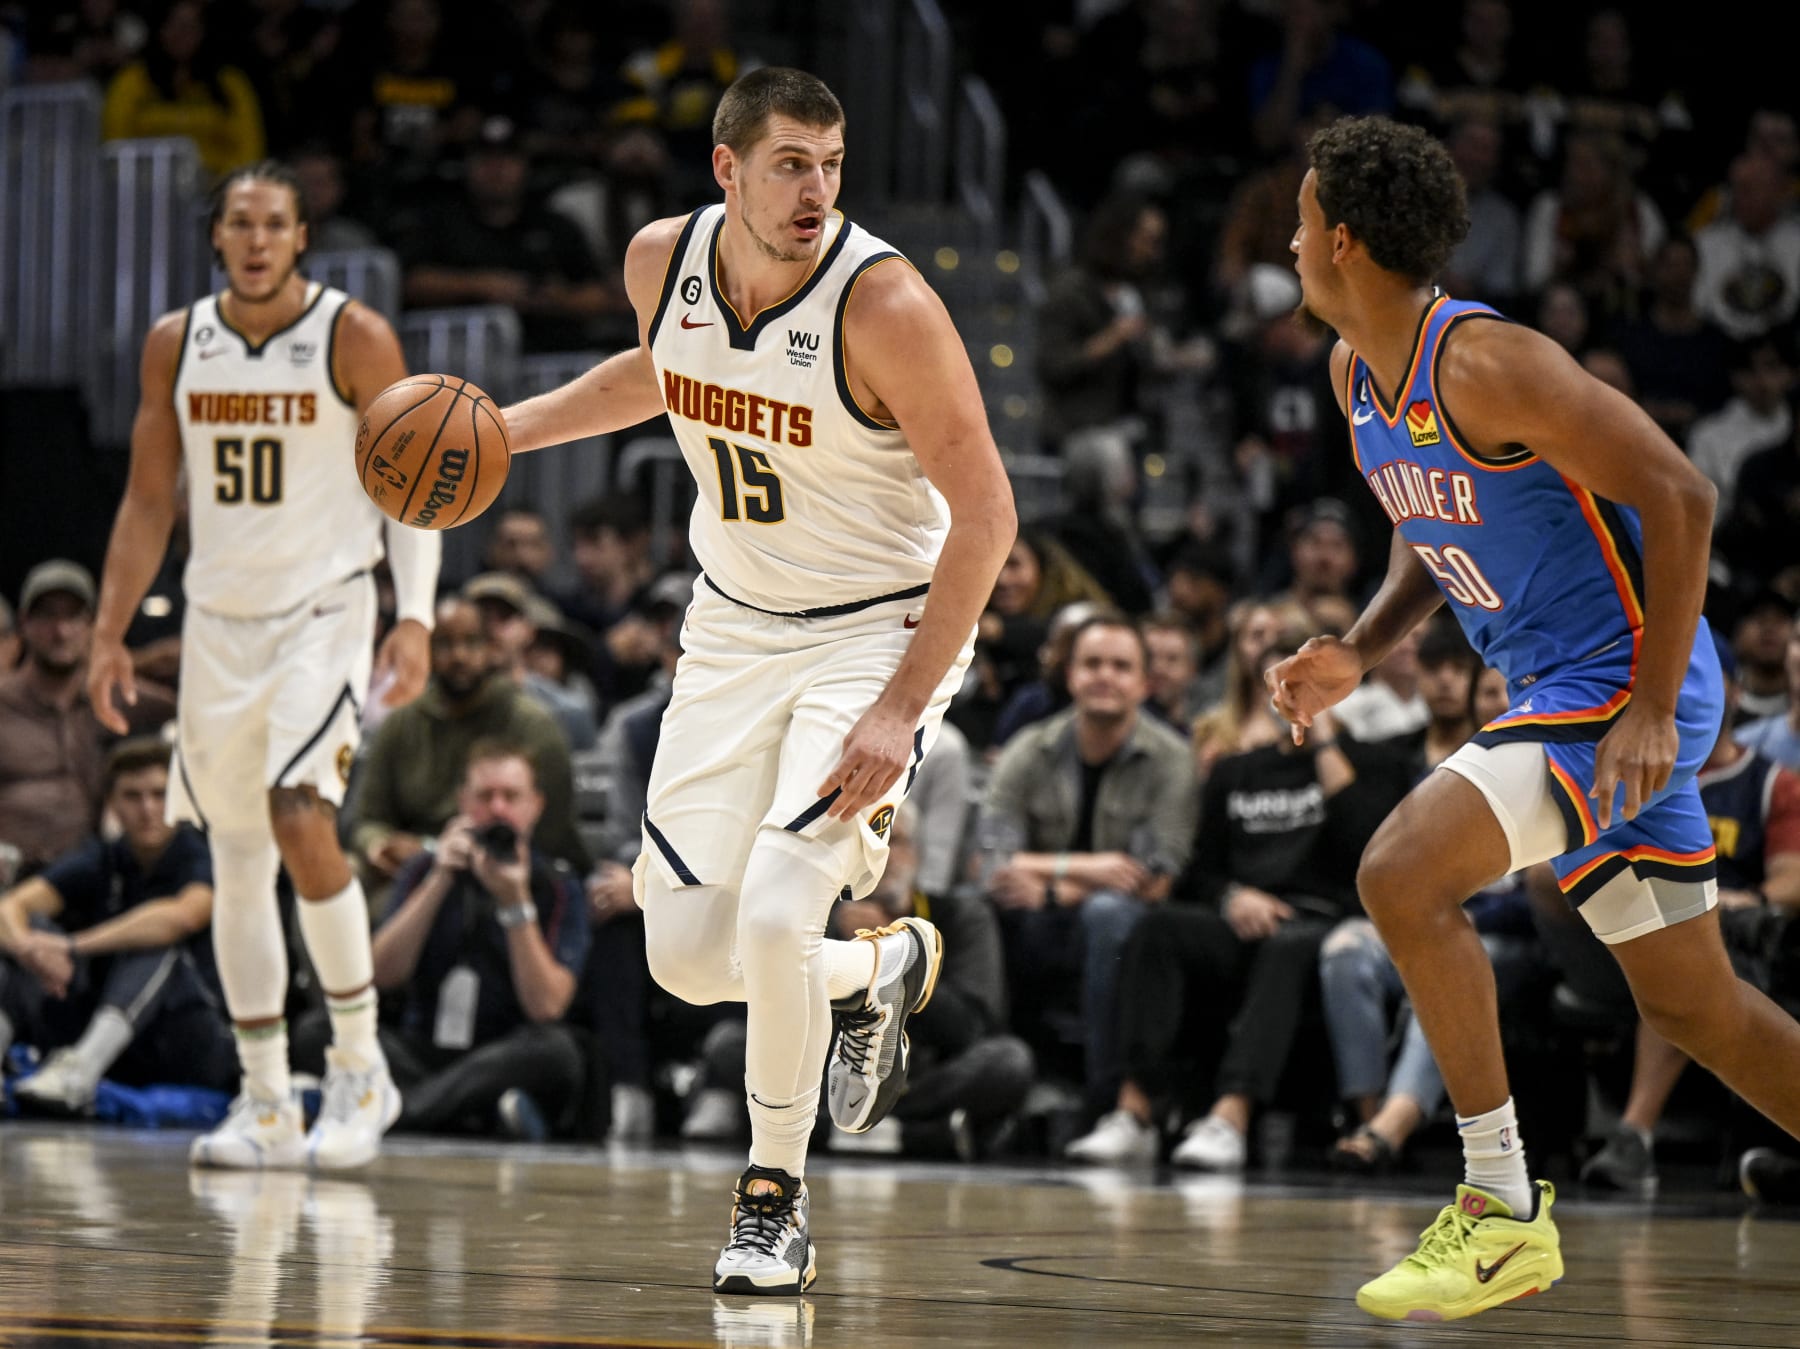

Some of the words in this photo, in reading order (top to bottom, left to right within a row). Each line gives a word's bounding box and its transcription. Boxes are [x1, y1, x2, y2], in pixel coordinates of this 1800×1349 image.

[684, 278, 701, 303] 6
[786, 349, 817, 361] Western
[788, 330, 820, 351] WU
[790, 358, 812, 369] Union
[188, 391, 318, 425] NUGGETS
[663, 368, 814, 447] NUGGETS
[213, 436, 284, 505] 50
[411, 448, 469, 527] Wilson
[705, 434, 786, 526] 15
[1368, 458, 1483, 527] HUNDER
[1408, 544, 1503, 612] 50
